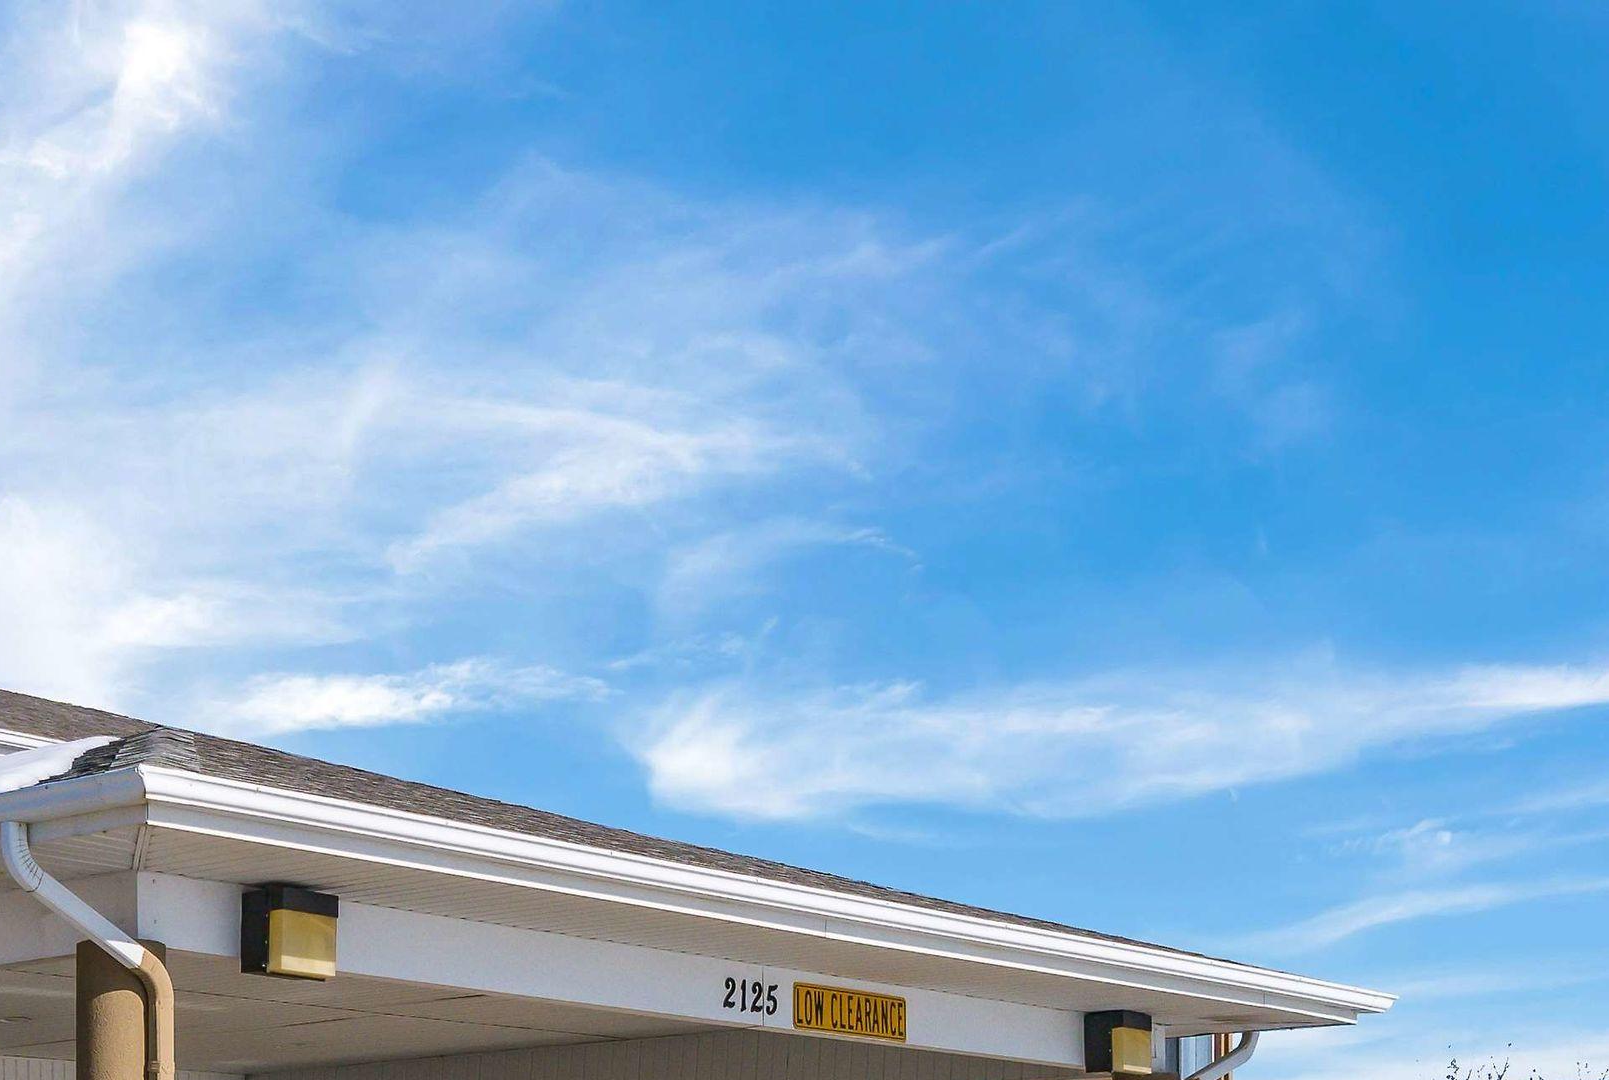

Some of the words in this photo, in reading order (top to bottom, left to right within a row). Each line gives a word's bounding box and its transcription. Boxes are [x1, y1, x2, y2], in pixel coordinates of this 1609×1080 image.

[723, 977, 778, 1015] 2125
[796, 988, 824, 1026] LOW
[831, 993, 904, 1037] CLEARANCE
